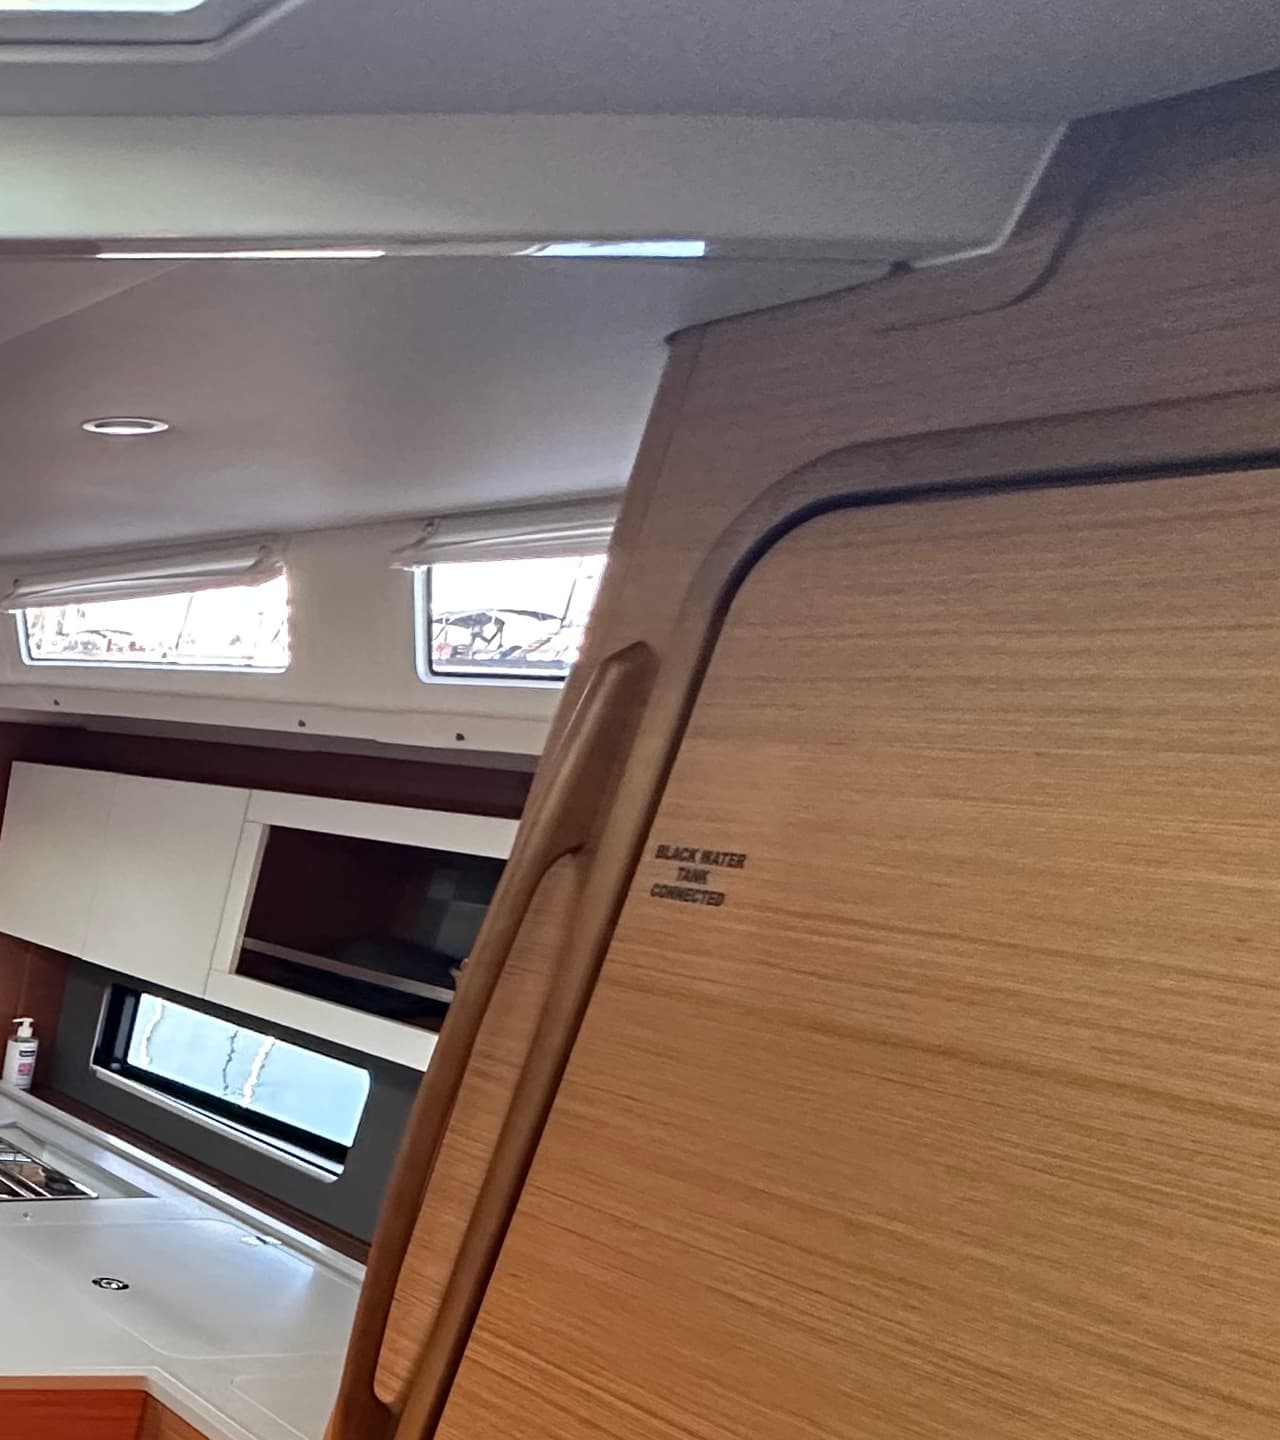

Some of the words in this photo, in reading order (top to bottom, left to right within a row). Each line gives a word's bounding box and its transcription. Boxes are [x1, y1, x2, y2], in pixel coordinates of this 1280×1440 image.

[654, 844, 699, 863] BLACK
[700, 849, 746, 869] WATER
[676, 866, 711, 885] TANK
[650, 883, 725, 907] CONNECTED
